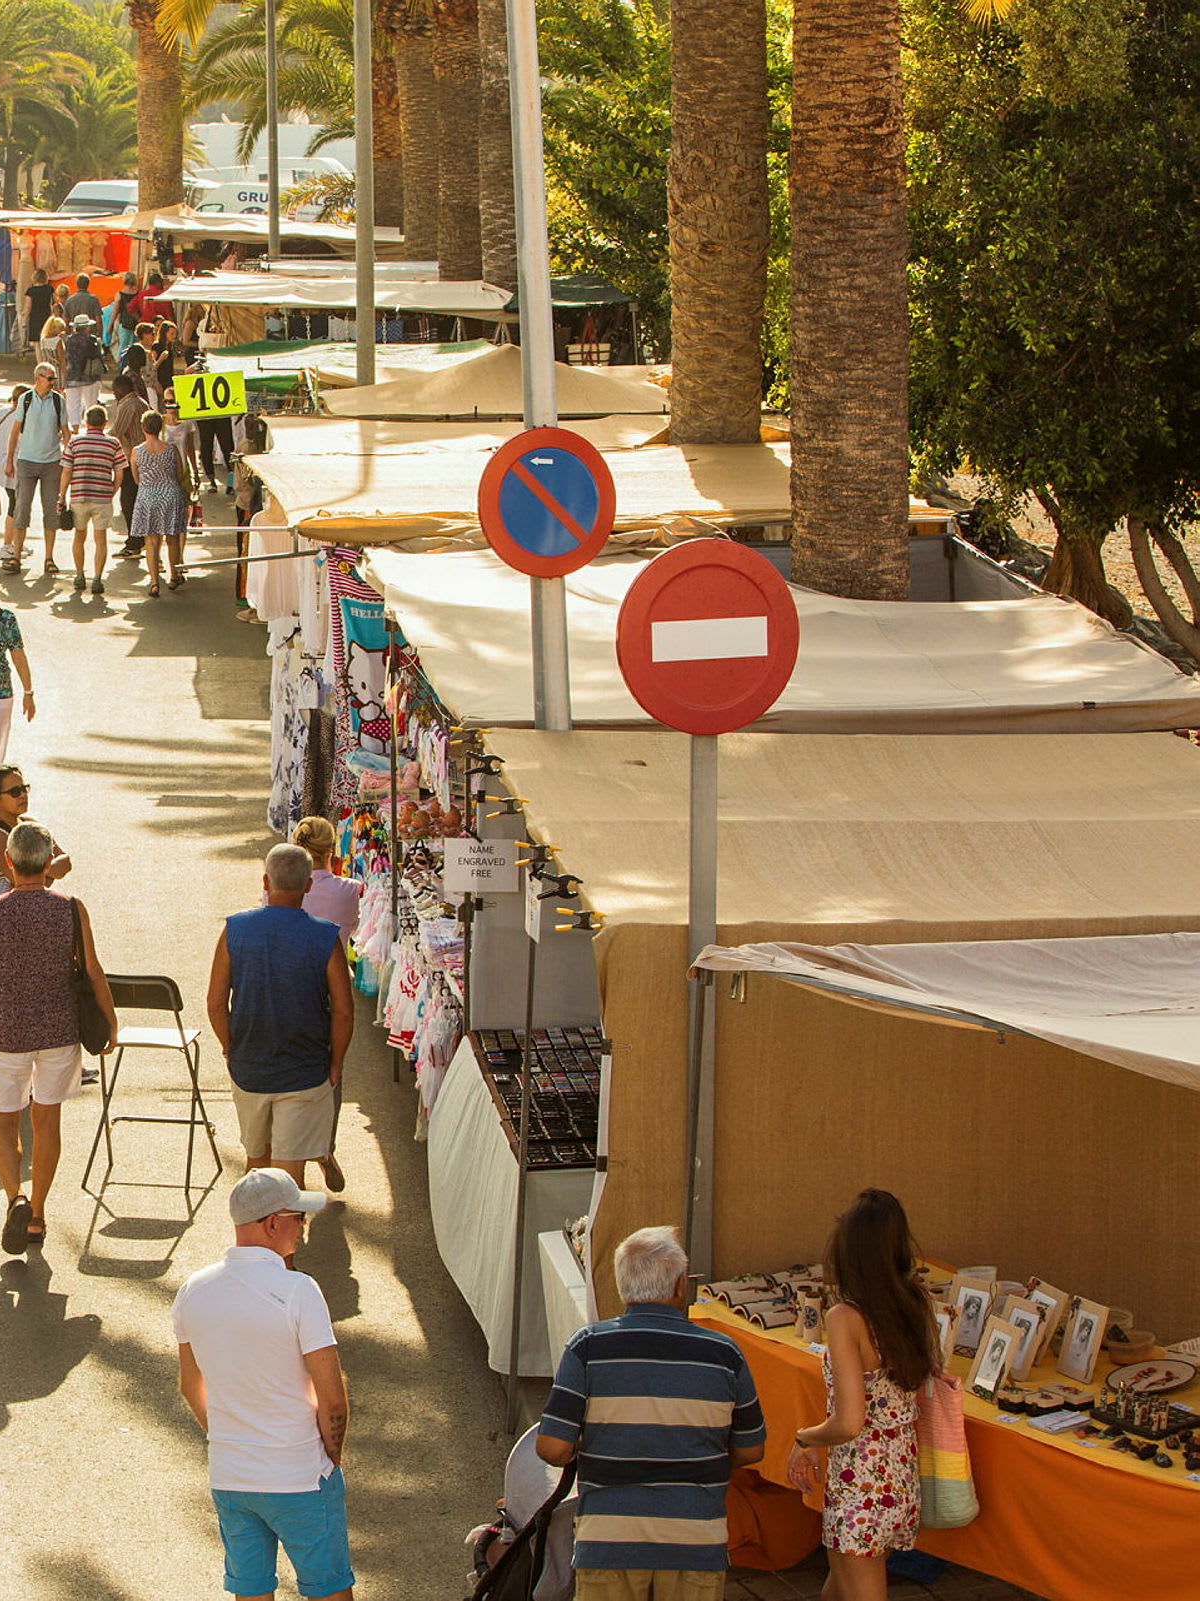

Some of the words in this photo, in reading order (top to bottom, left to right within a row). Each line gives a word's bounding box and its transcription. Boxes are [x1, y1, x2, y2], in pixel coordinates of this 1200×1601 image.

[469, 845, 495, 854] NAME
[457, 857, 506, 867] ENGRAVED
[471, 869, 492, 879] FREE
